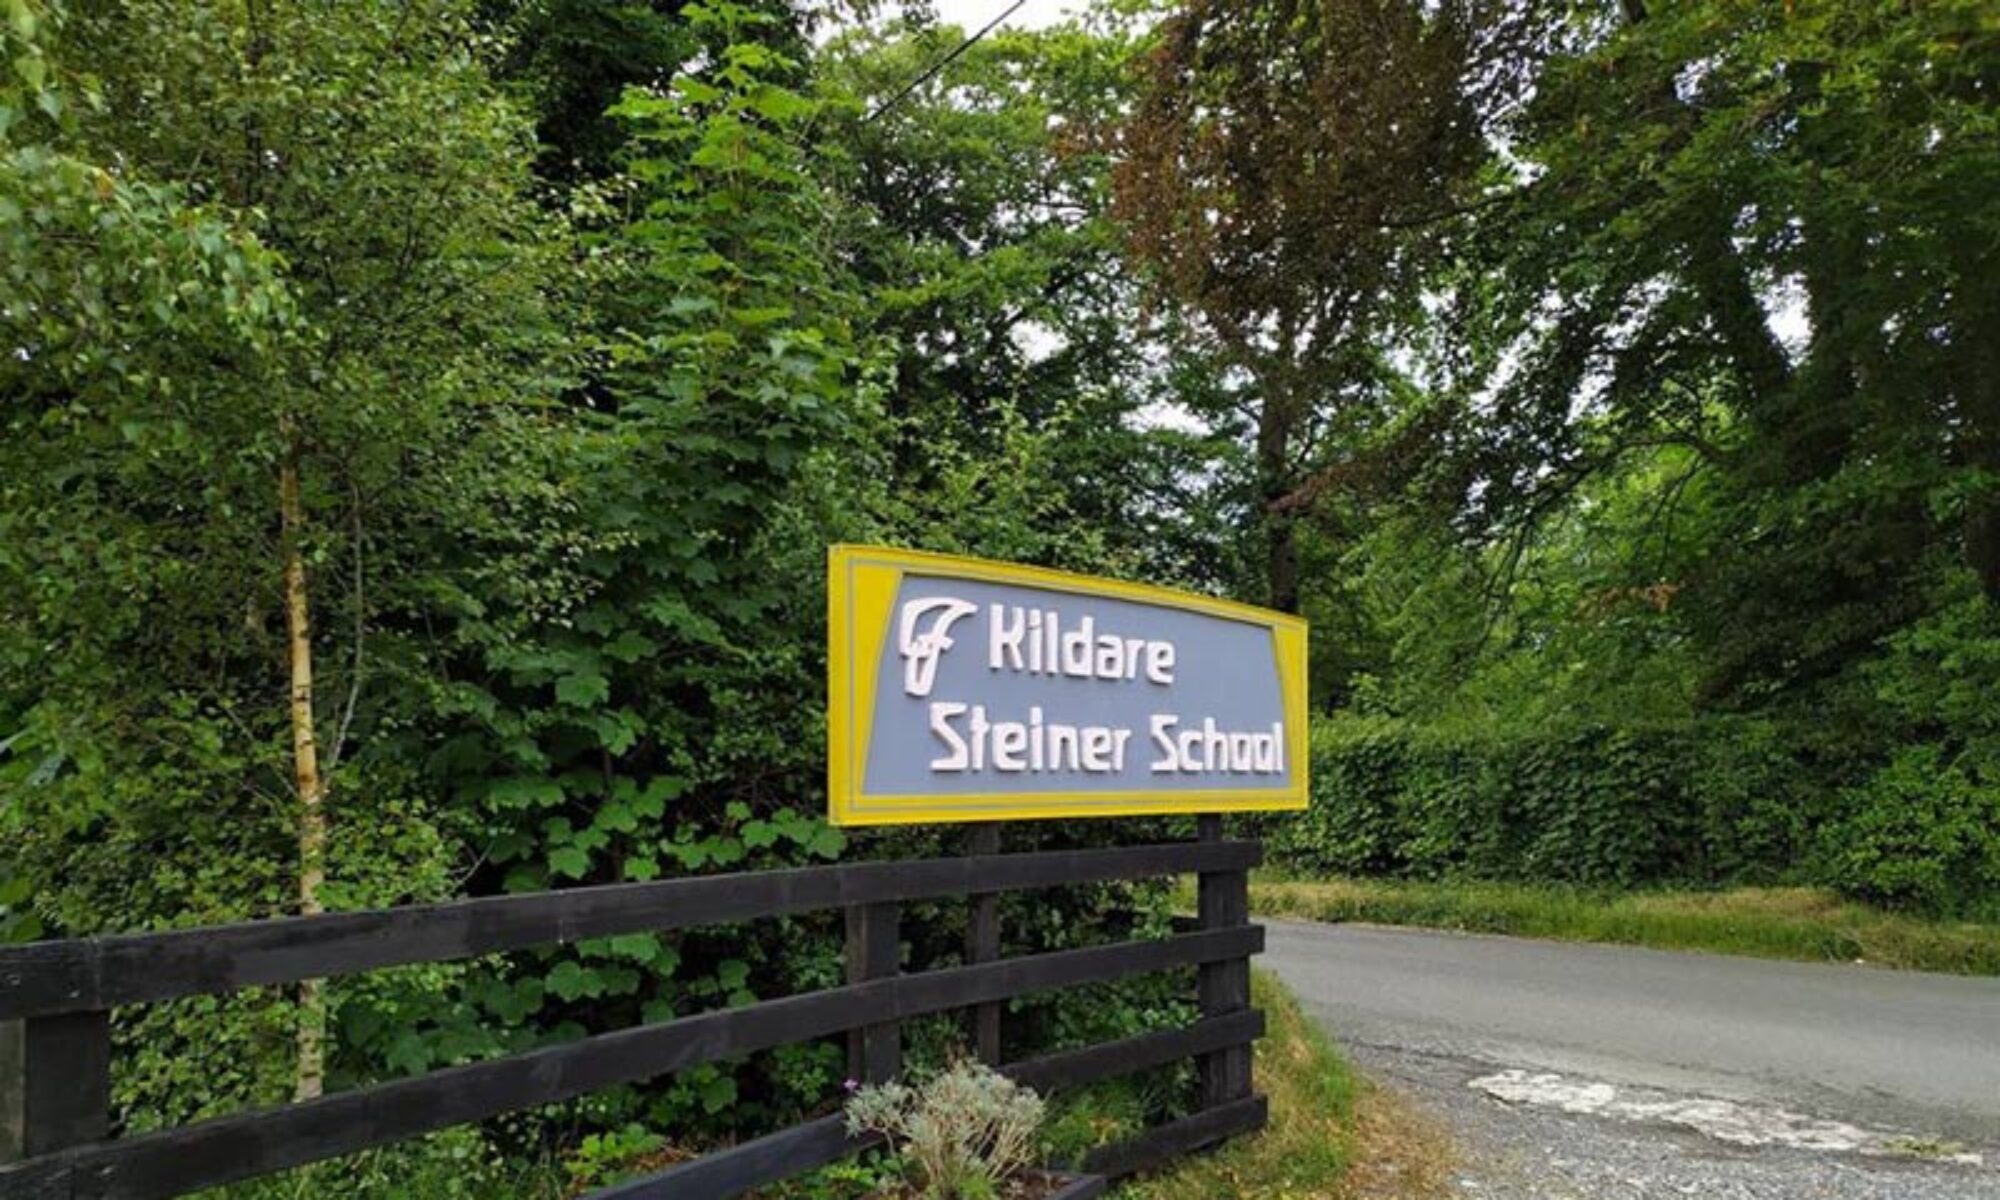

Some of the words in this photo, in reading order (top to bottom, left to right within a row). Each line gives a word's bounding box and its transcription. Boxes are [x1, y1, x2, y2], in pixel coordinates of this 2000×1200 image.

[989, 603, 1175, 684] Kildare
[930, 701, 1132, 772] Steiner
[1150, 714, 1284, 774] School
